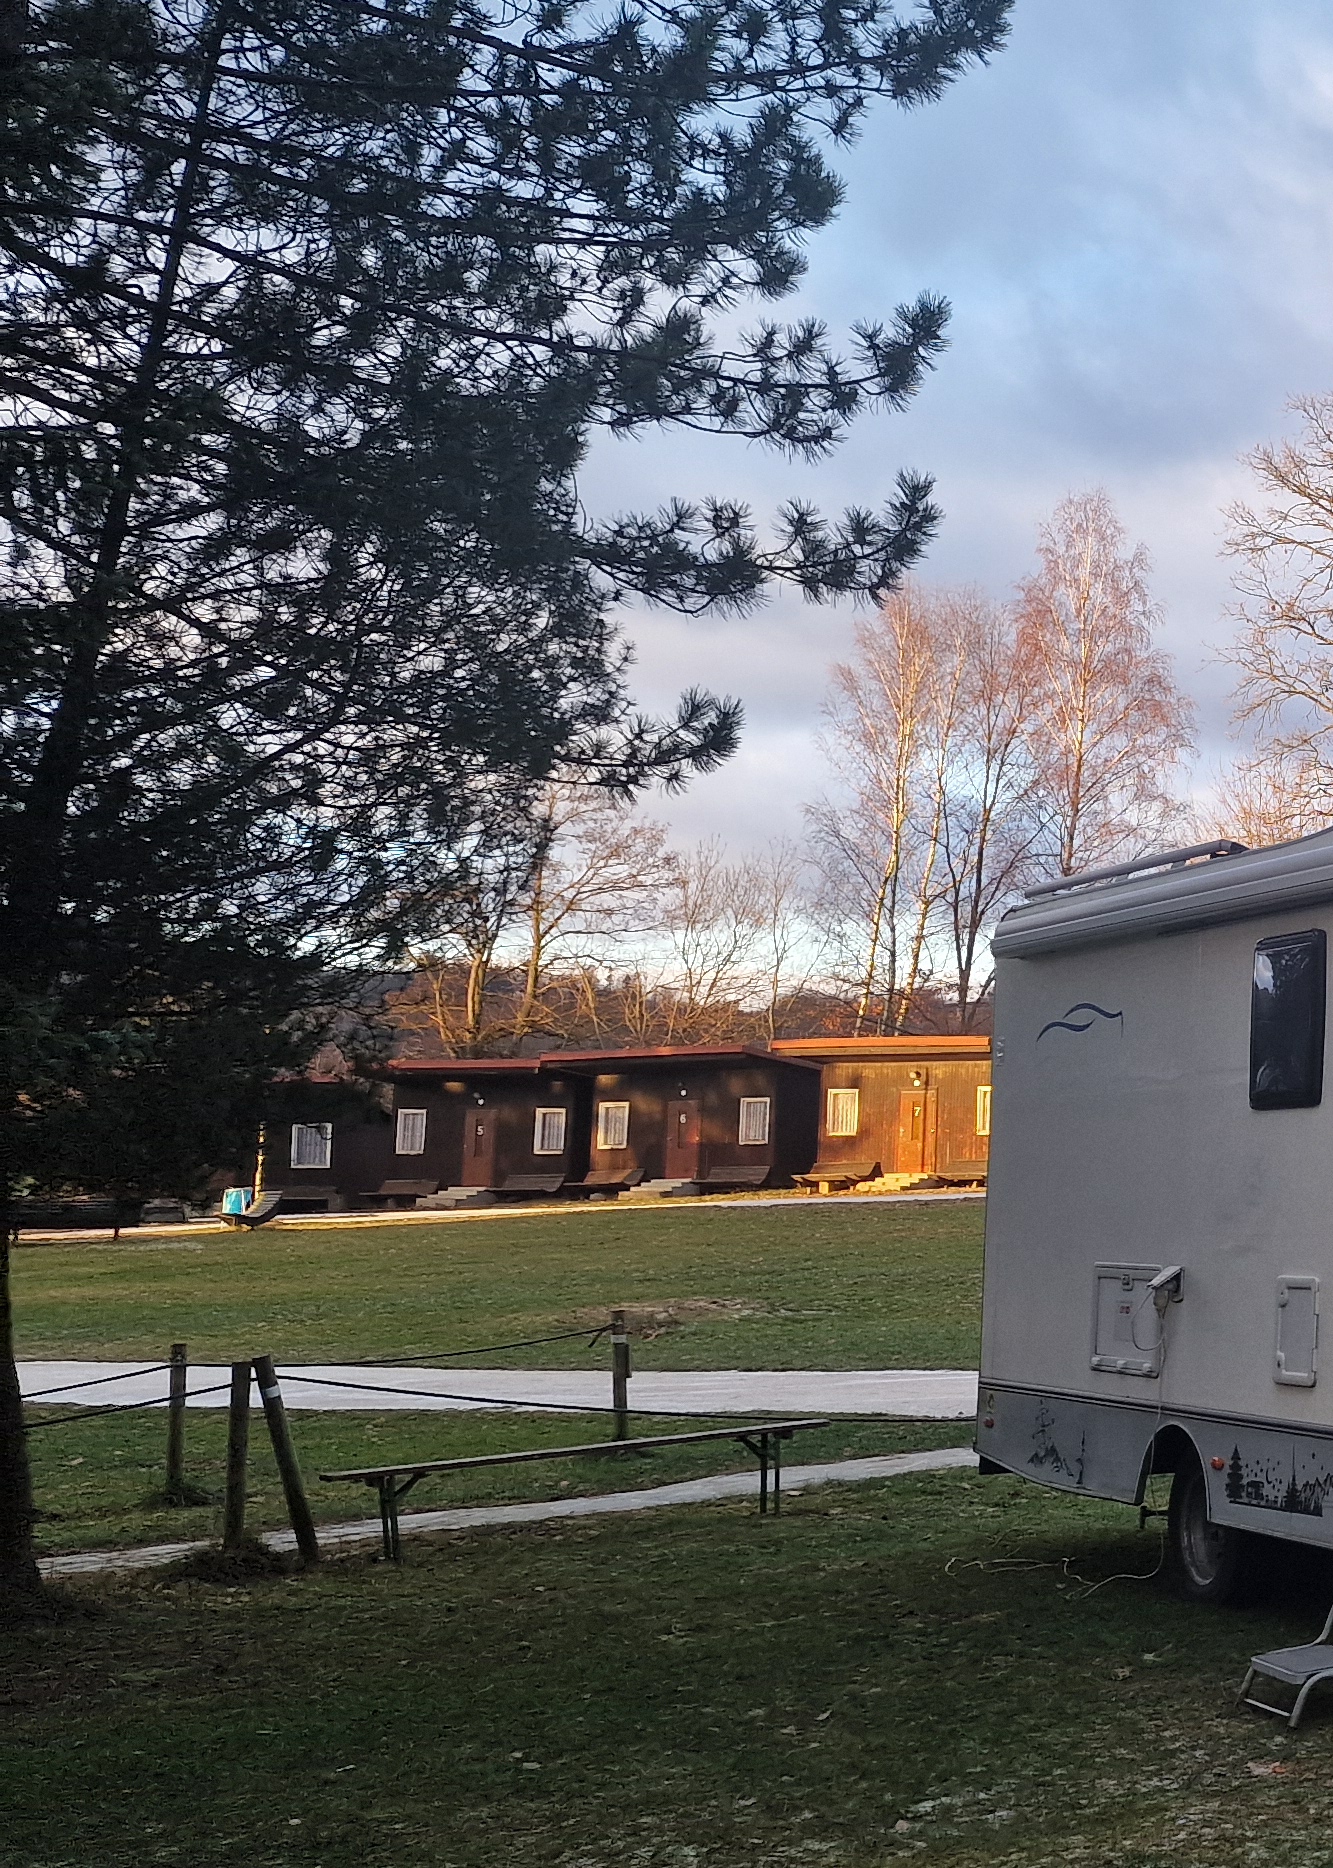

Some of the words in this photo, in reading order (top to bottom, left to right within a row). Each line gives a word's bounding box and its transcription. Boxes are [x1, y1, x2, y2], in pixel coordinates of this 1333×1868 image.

[914, 1106, 921, 1117] 7
[679, 1113, 687, 1124] 6
[476, 1125, 484, 1136] 5
